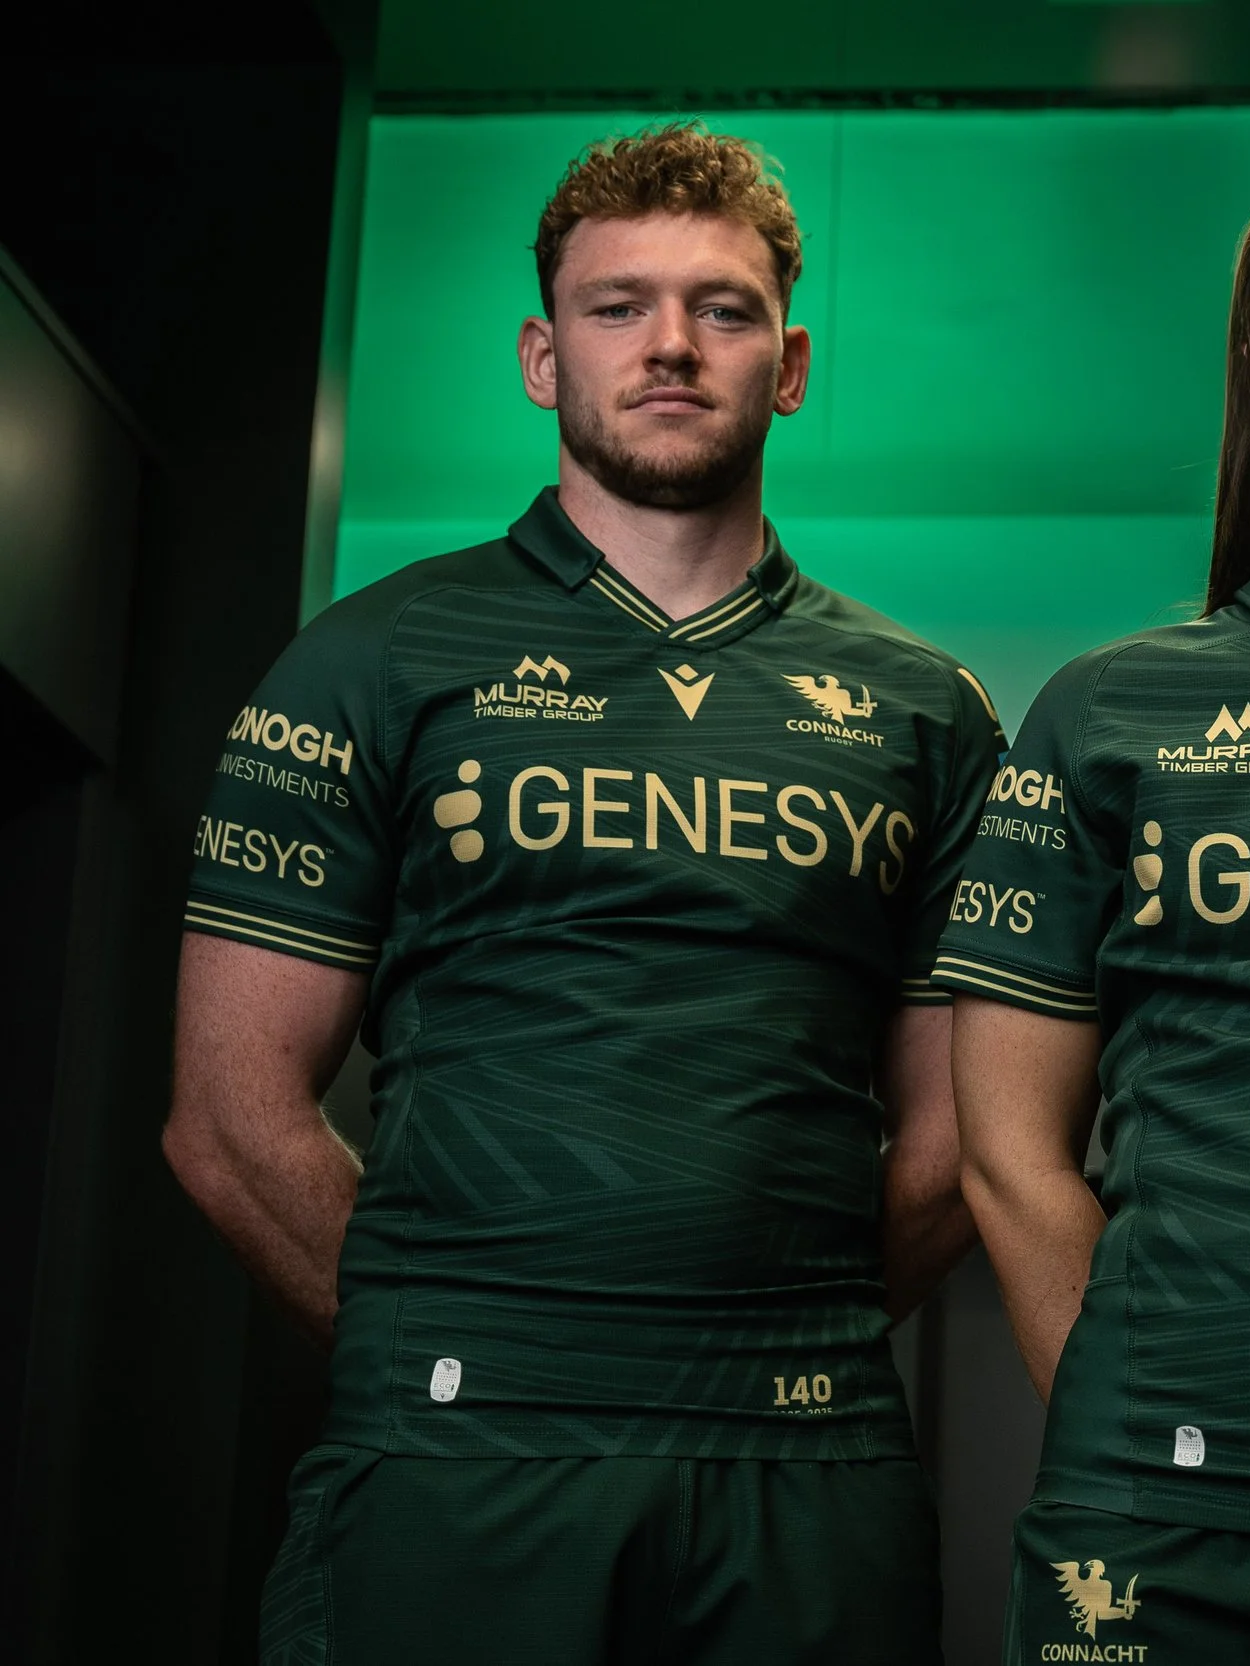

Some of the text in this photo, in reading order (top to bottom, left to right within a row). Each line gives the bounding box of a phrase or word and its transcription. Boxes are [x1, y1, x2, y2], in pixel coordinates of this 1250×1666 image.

[474, 682, 608, 712] MURRAY
[473, 705, 605, 722] TIMBER GROUP
[227, 705, 354, 776] ONOGH
[786, 719, 884, 748] CONNACHT
[824, 736, 853, 747] RUGBY
[216, 752, 350, 808] NVESTMENTS
[1157, 761, 1228, 773] TIMBER
[508, 765, 915, 896] GENESYS
[773, 1374, 832, 1406] 140
[1041, 1643, 1148, 1663] CONNACHT
